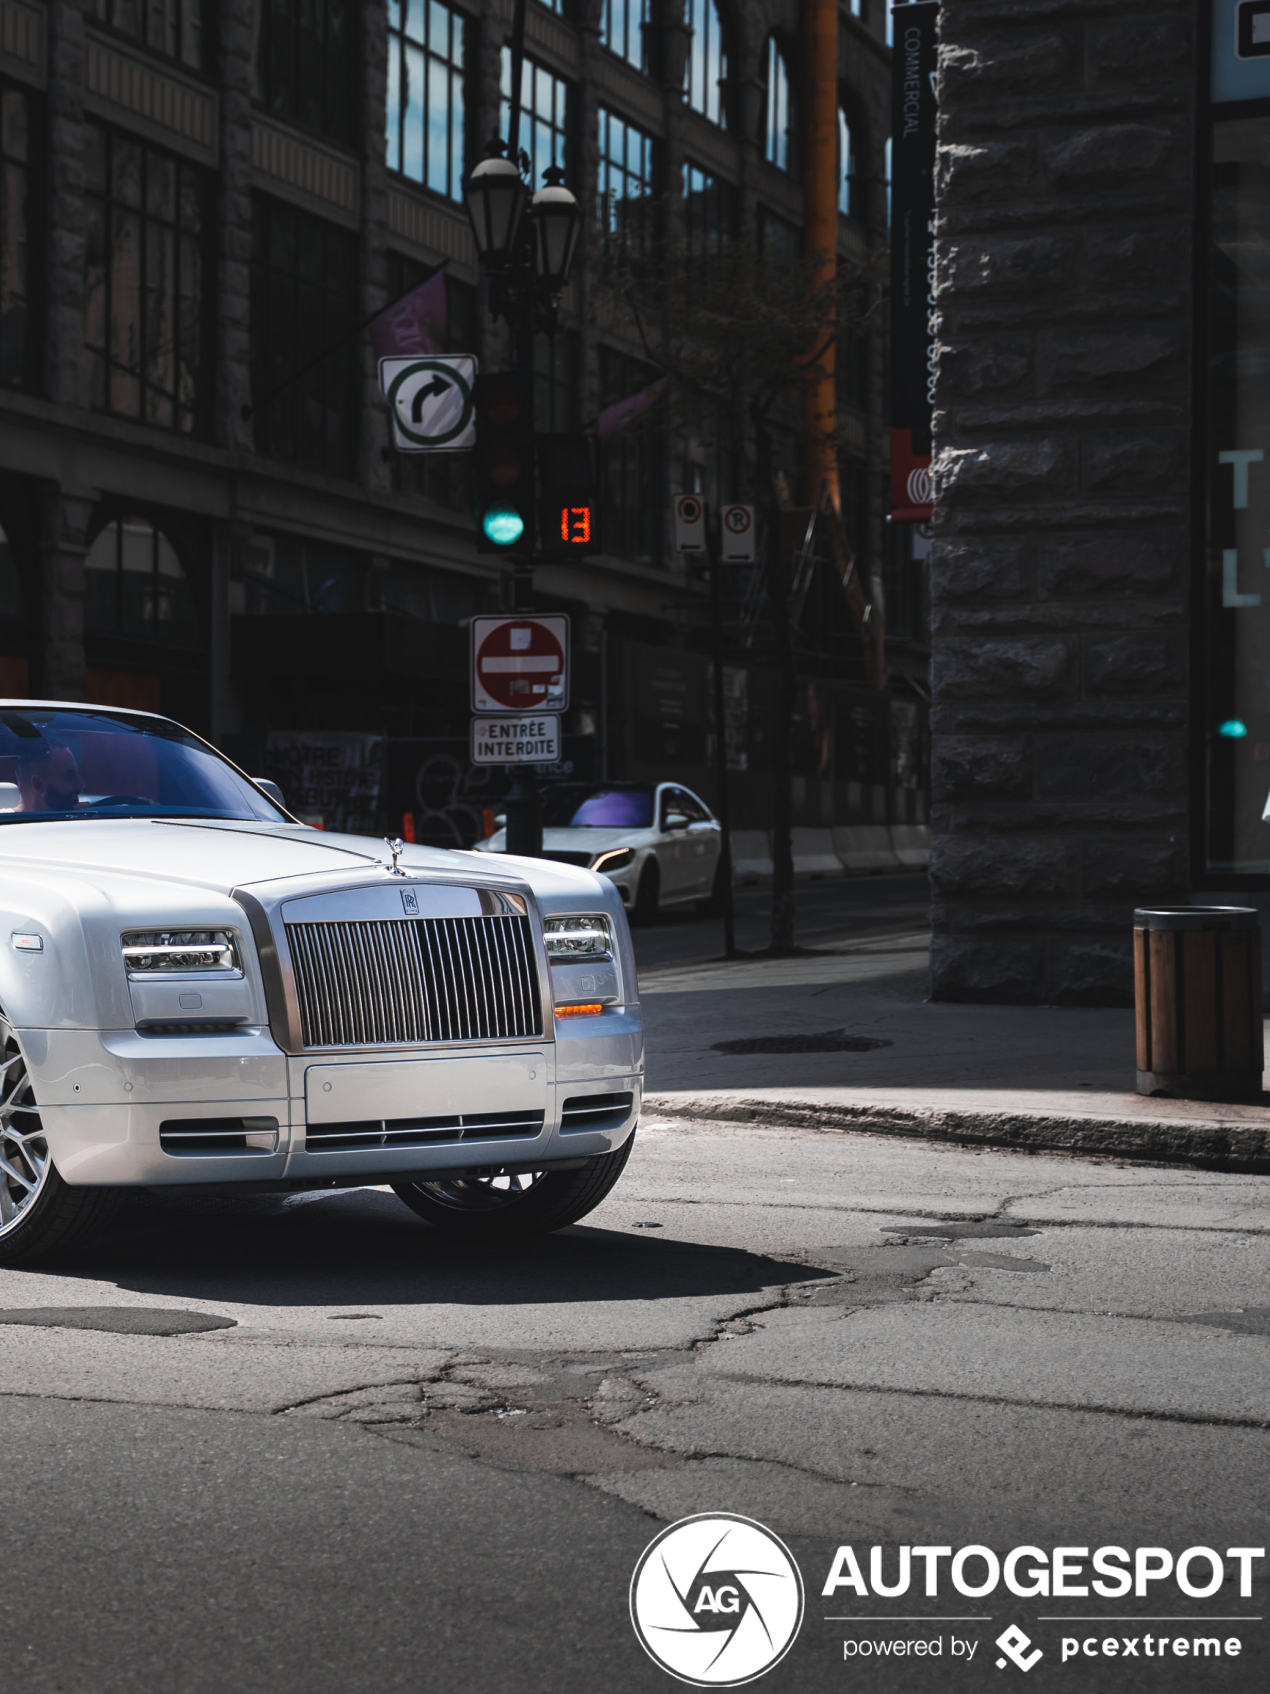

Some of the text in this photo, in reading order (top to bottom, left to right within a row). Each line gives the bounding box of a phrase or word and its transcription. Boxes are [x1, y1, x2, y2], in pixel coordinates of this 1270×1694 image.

[903, 27, 922, 140] COMMERCIAL
[561, 507, 590, 543] 13
[488, 720, 545, 738] ENTRÉE
[478, 739, 555, 756] INTERDITE
